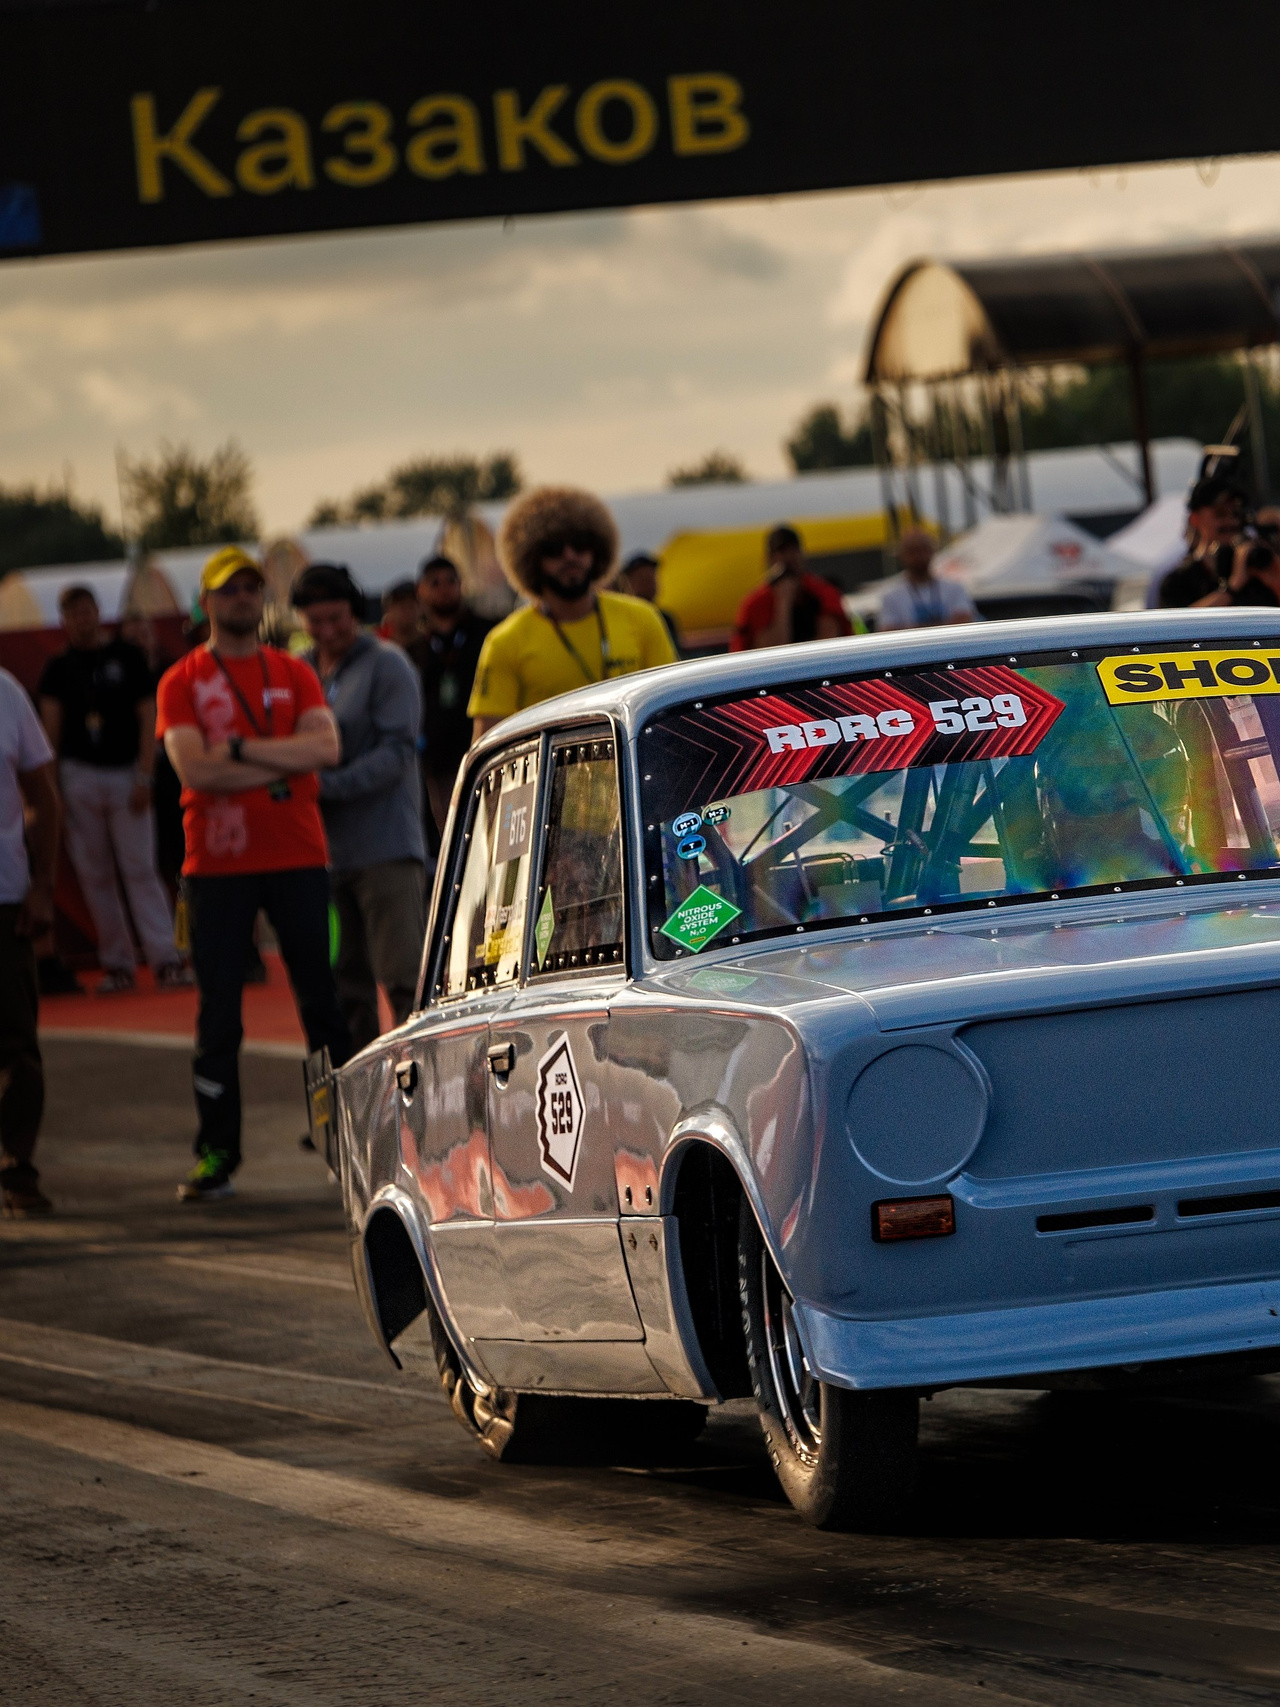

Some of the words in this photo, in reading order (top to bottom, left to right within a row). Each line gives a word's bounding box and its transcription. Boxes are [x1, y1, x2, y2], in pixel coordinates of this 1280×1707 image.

[129, 71, 751, 204] Казаков
[762, 709, 915, 754] RDRC
[928, 693, 1028, 735] 529
[708, 808, 725, 819] M-2
[508, 805, 528, 847] ВТБ
[679, 819, 696, 830] M-1
[677, 902, 723, 919] NITROUS
[683, 911, 716, 924] OXIDE
[679, 916, 719, 933] SYSTEM
[551, 1090, 573, 1135] 529
